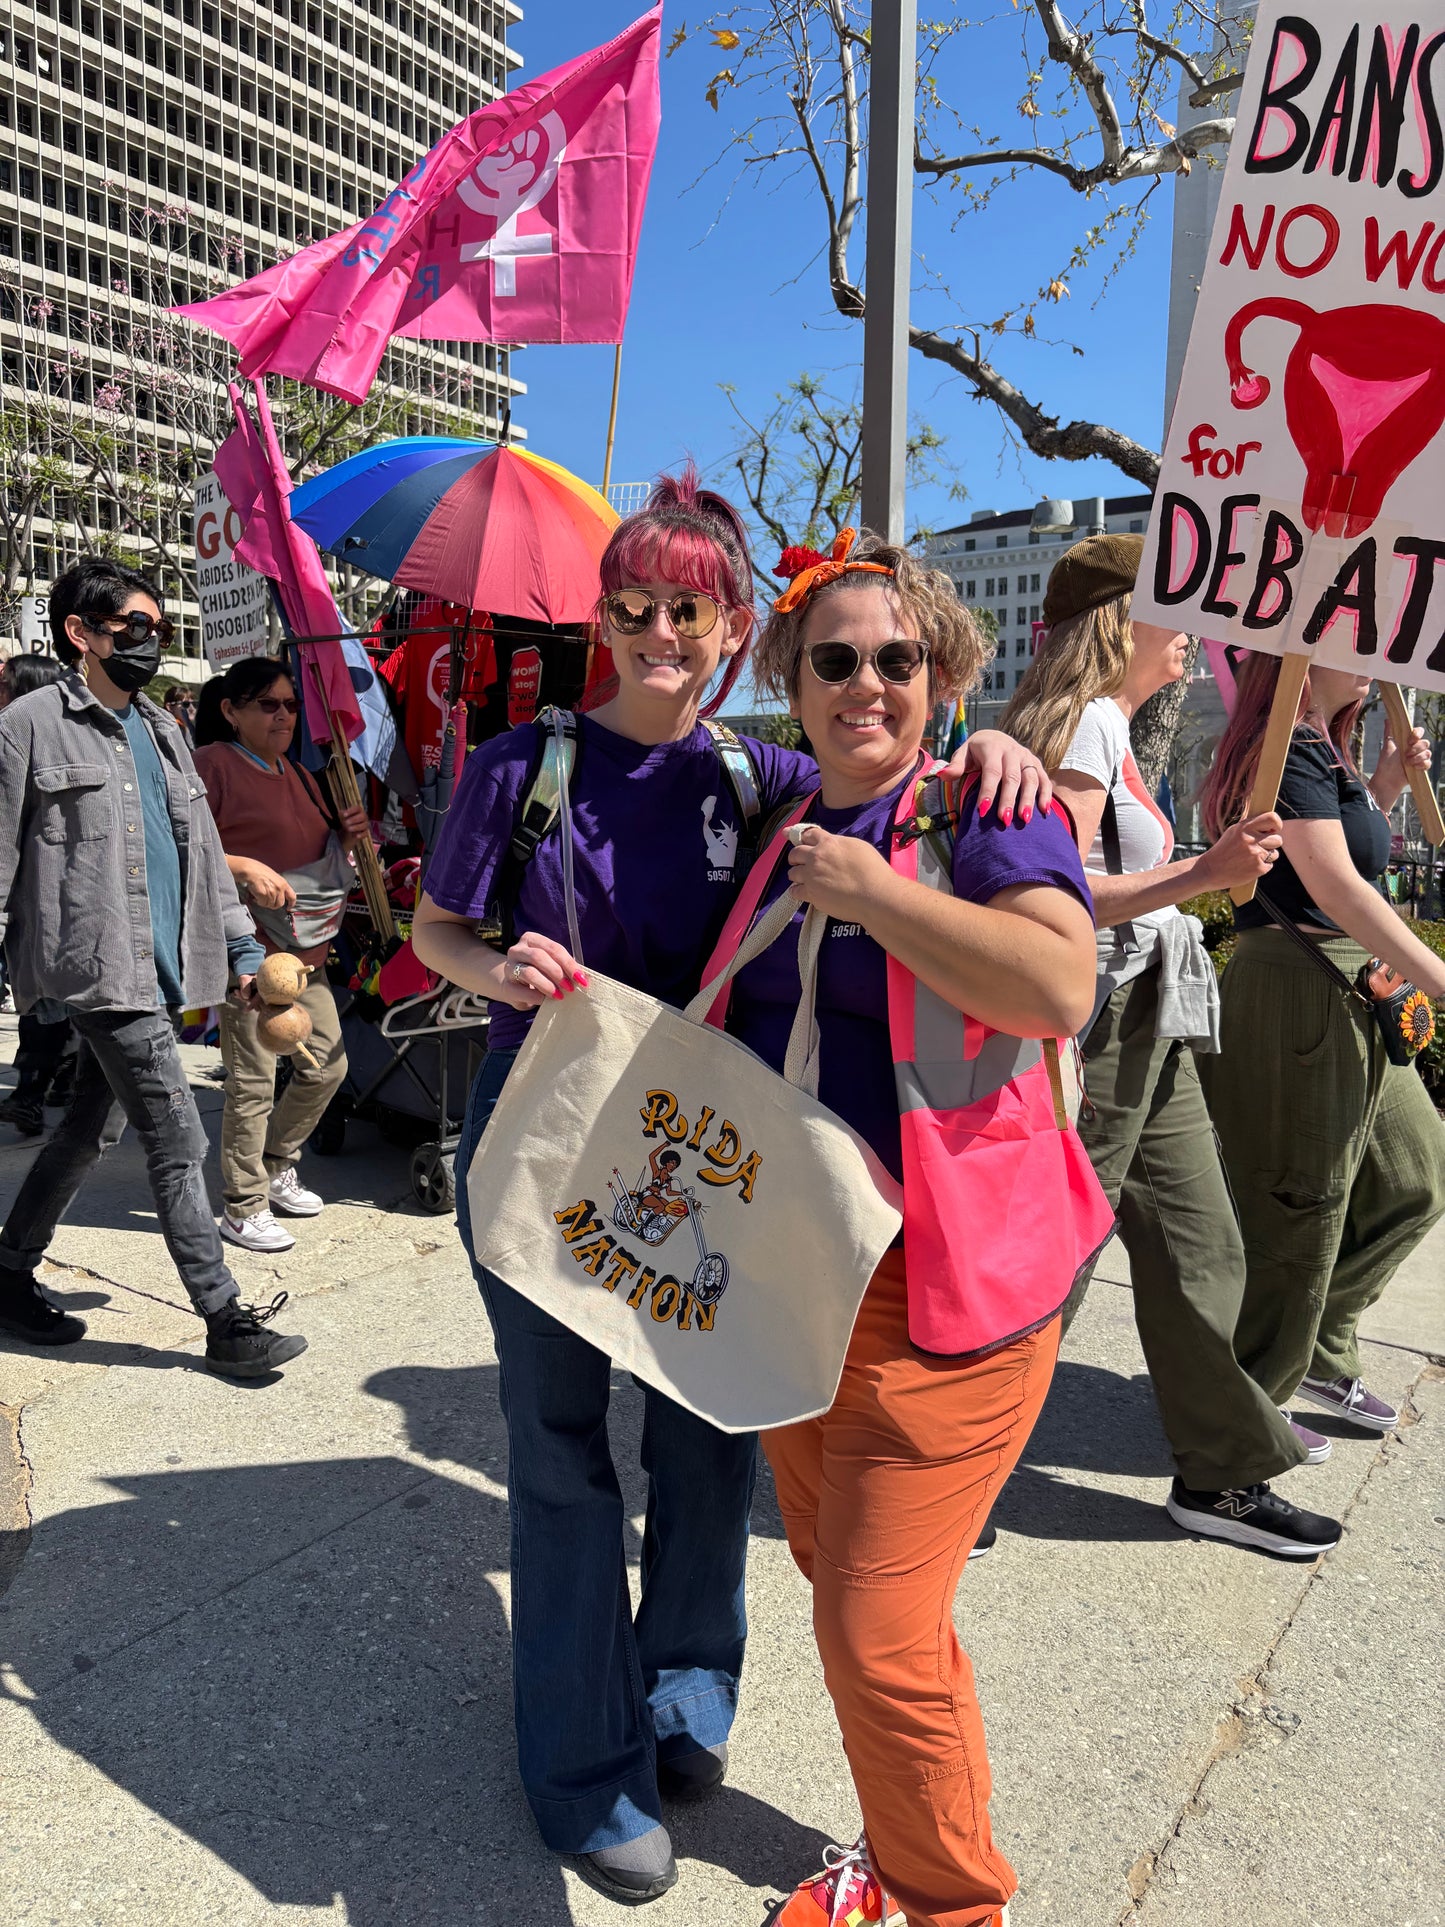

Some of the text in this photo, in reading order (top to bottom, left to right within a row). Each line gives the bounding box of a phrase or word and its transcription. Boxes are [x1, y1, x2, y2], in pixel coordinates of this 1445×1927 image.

[1245, 15, 1445, 198] BANS
[1220, 203, 1340, 278] NO
[1181, 422, 1262, 479] for
[196, 482, 213, 507] THE
[199, 562, 234, 588] ABIDES
[202, 576, 265, 614] CHILDREN OF
[831, 924, 861, 938] 50501
[639, 1088, 763, 1204] RIDA
[553, 1199, 718, 1332] NATION
